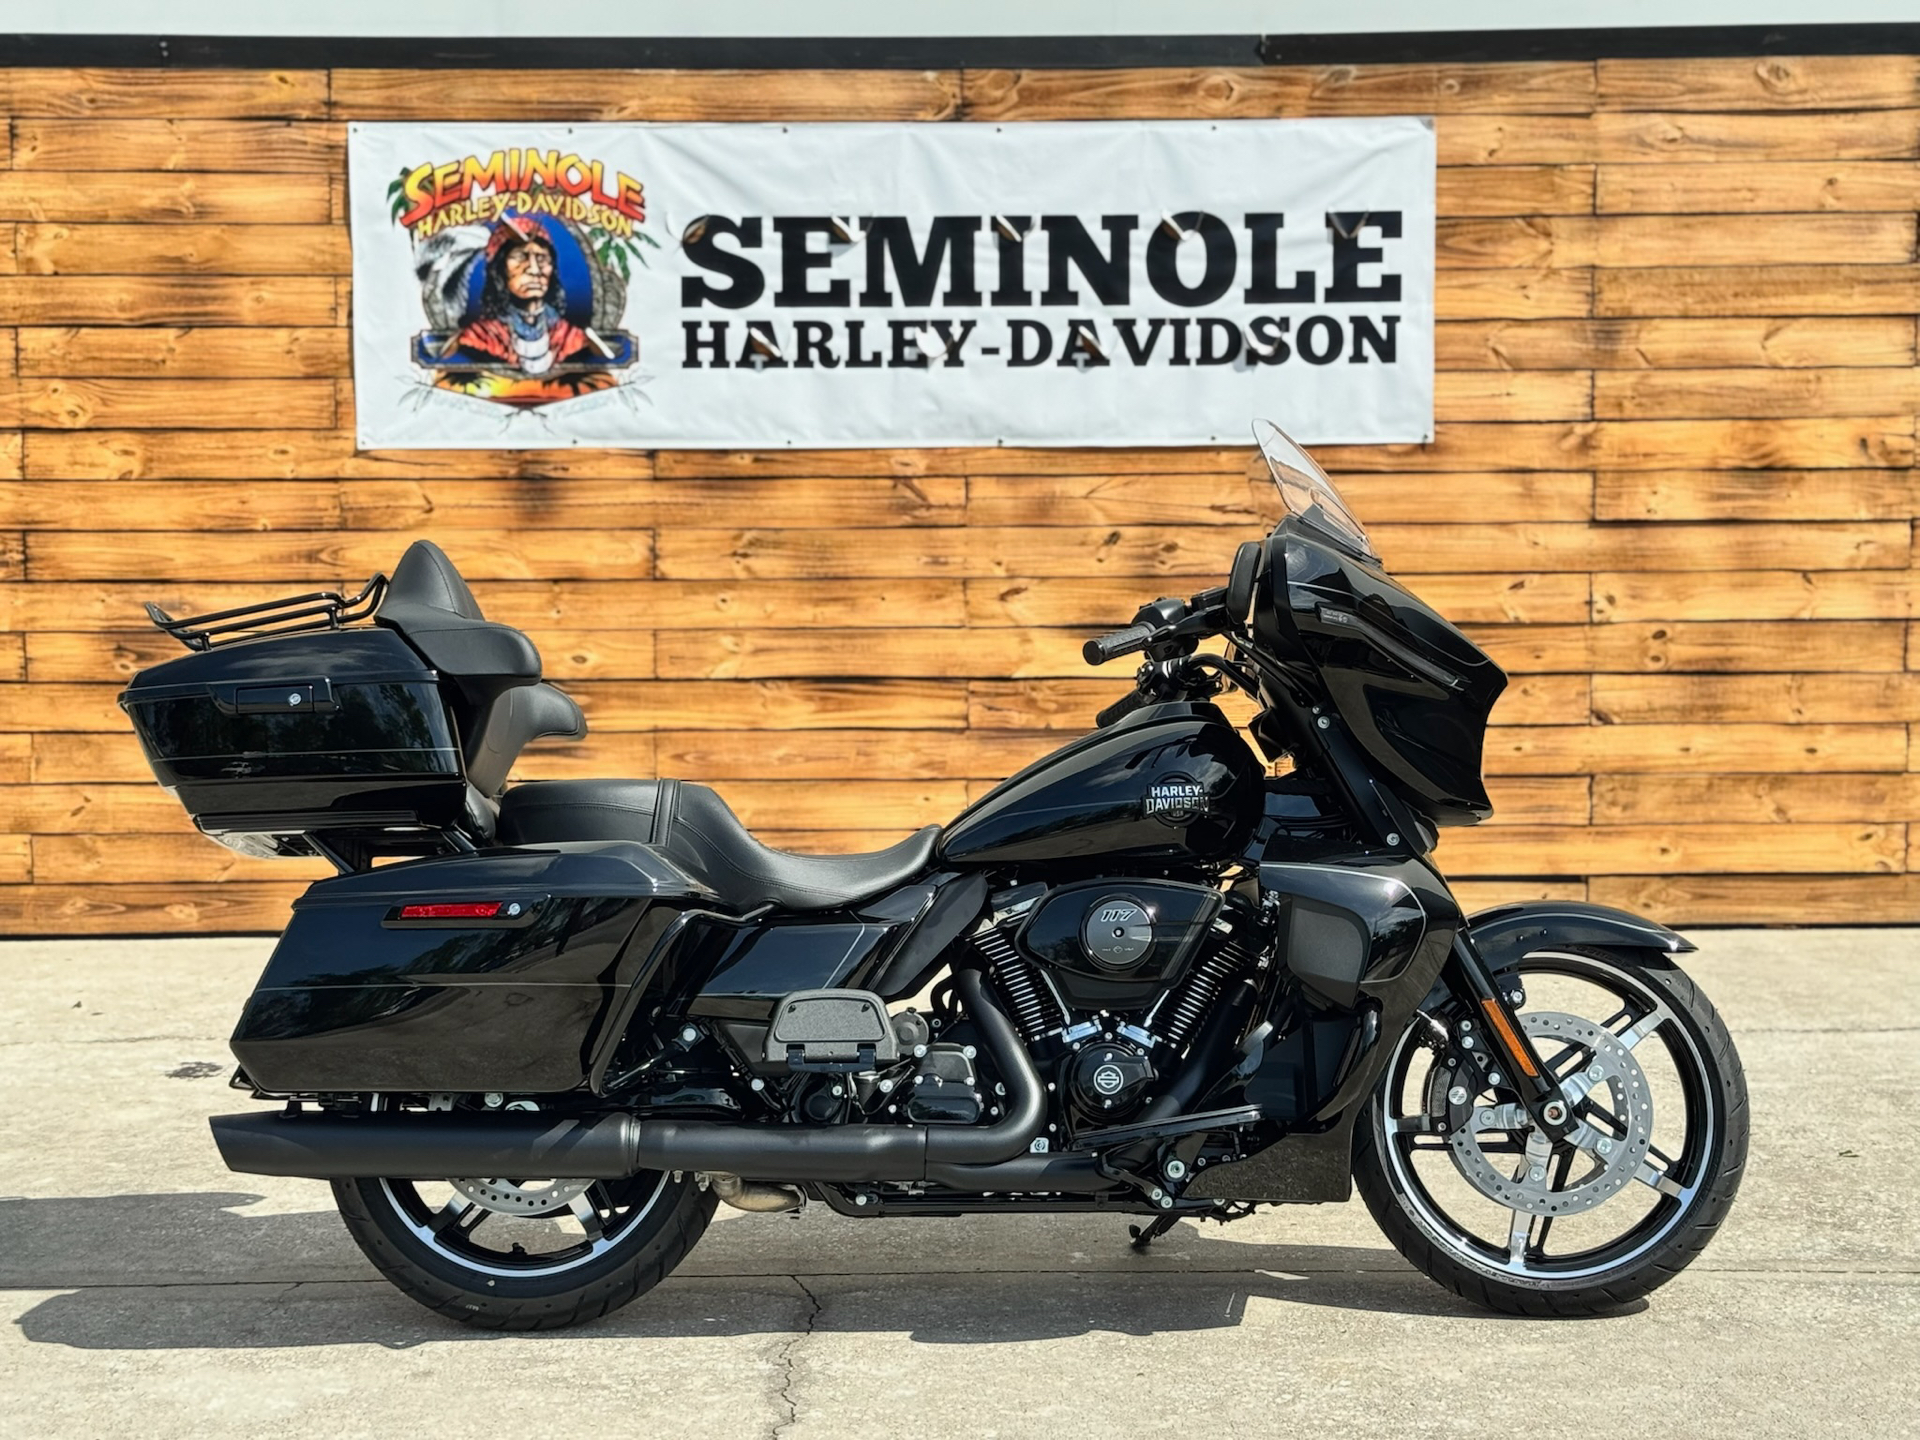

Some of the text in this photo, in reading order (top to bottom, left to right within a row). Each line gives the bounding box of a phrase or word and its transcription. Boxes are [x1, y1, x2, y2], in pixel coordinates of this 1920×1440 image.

[399, 148, 646, 227] SEMINOLE
[417, 192, 636, 241] HARLEY-DAVIDSON
[681, 210, 1402, 309] SEMINOLE
[682, 315, 1401, 369] HARLEY-DAVIDSON
[1145, 796, 1209, 815] DAVIDSON
[1100, 908, 1138, 923] 117
